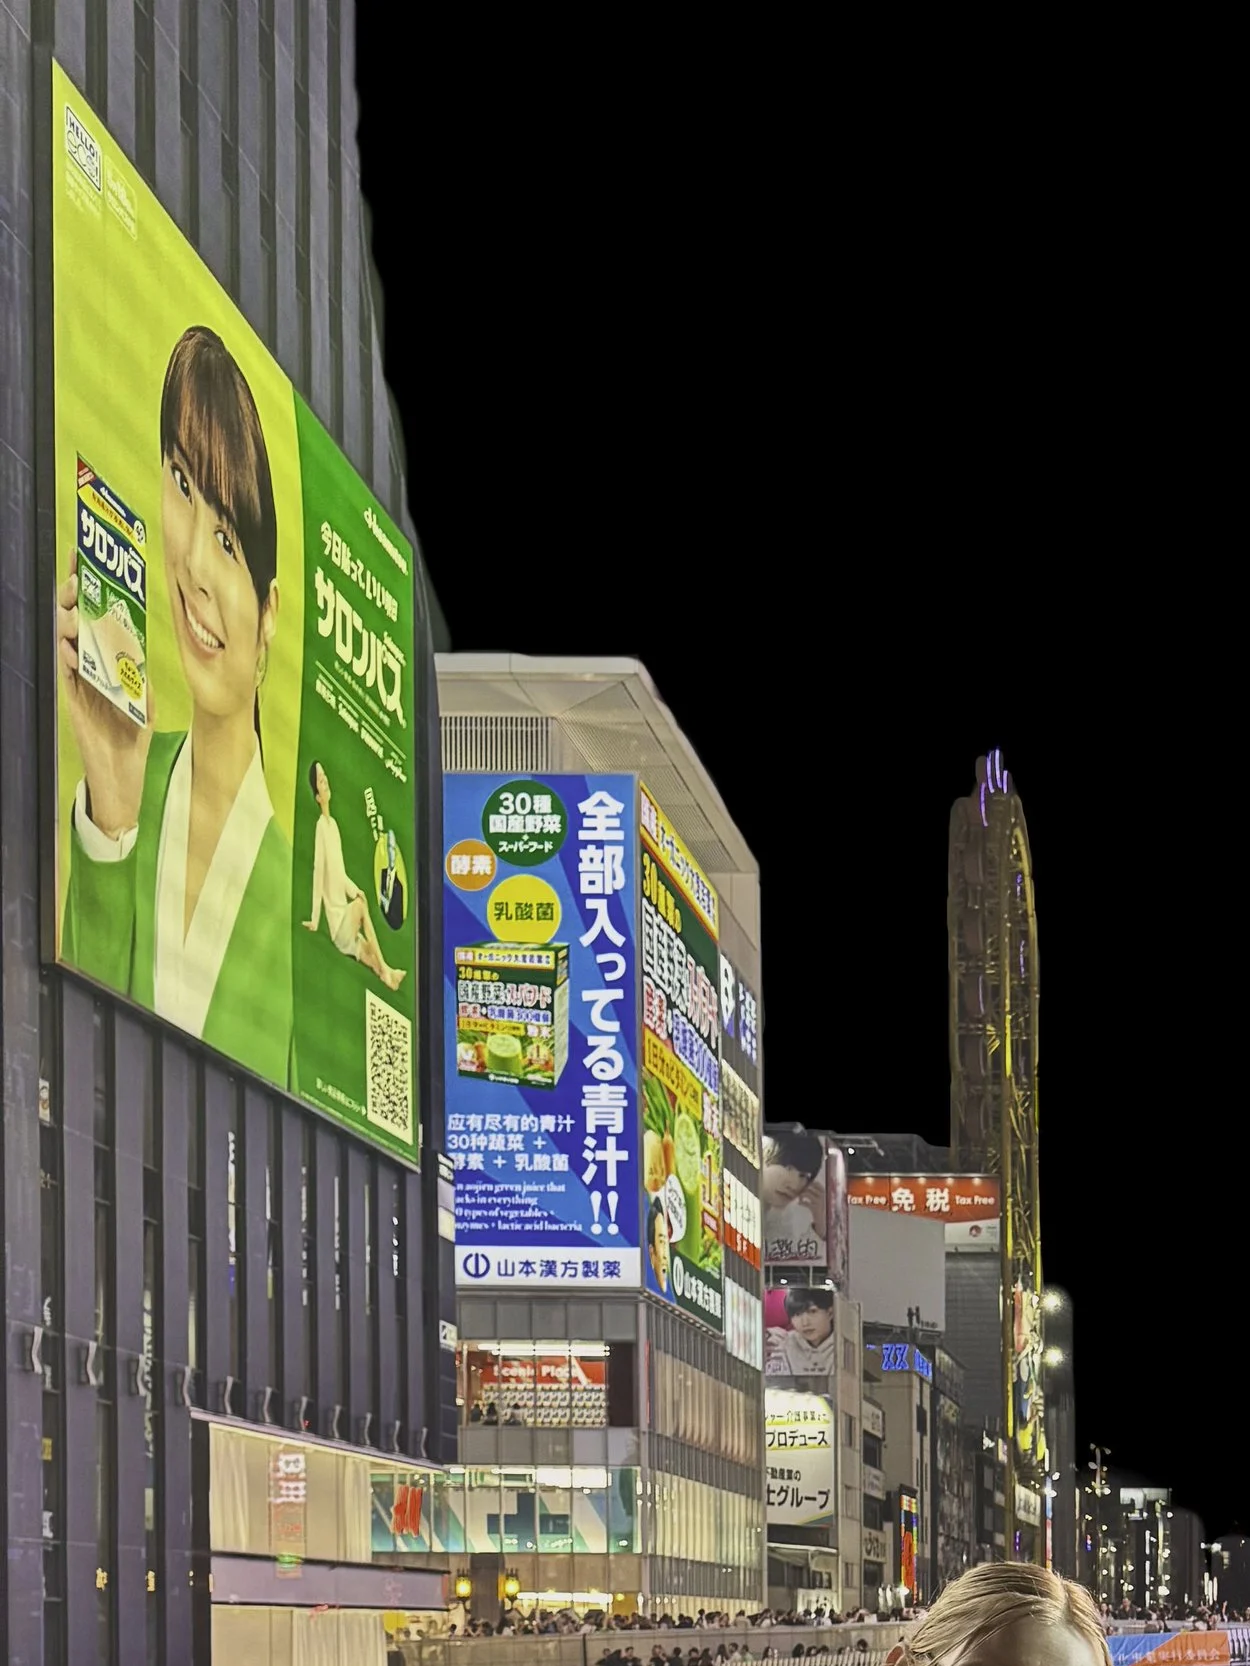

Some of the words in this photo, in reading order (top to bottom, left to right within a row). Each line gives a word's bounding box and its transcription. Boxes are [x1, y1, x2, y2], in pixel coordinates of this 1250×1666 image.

[80, 508, 145, 602] サロンパス
[315, 564, 407, 730] サロンパス
[498, 792, 553, 816] 30種
[488, 813, 562, 835] 国産野菜
[497, 840, 553, 854] スーパーフード
[493, 901, 555, 922] 乳酸菌
[577, 790, 629, 1236] 全部入ってる青汁!!
[448, 1113, 576, 1133] 应有尽有的青汁
[447, 1133, 525, 1152] 30种蔬菜
[514, 1153, 570, 1172] 乳酸菌
[892, 1186, 950, 1212] 免税
[497, 1258, 622, 1279] 山本漢方製薬
